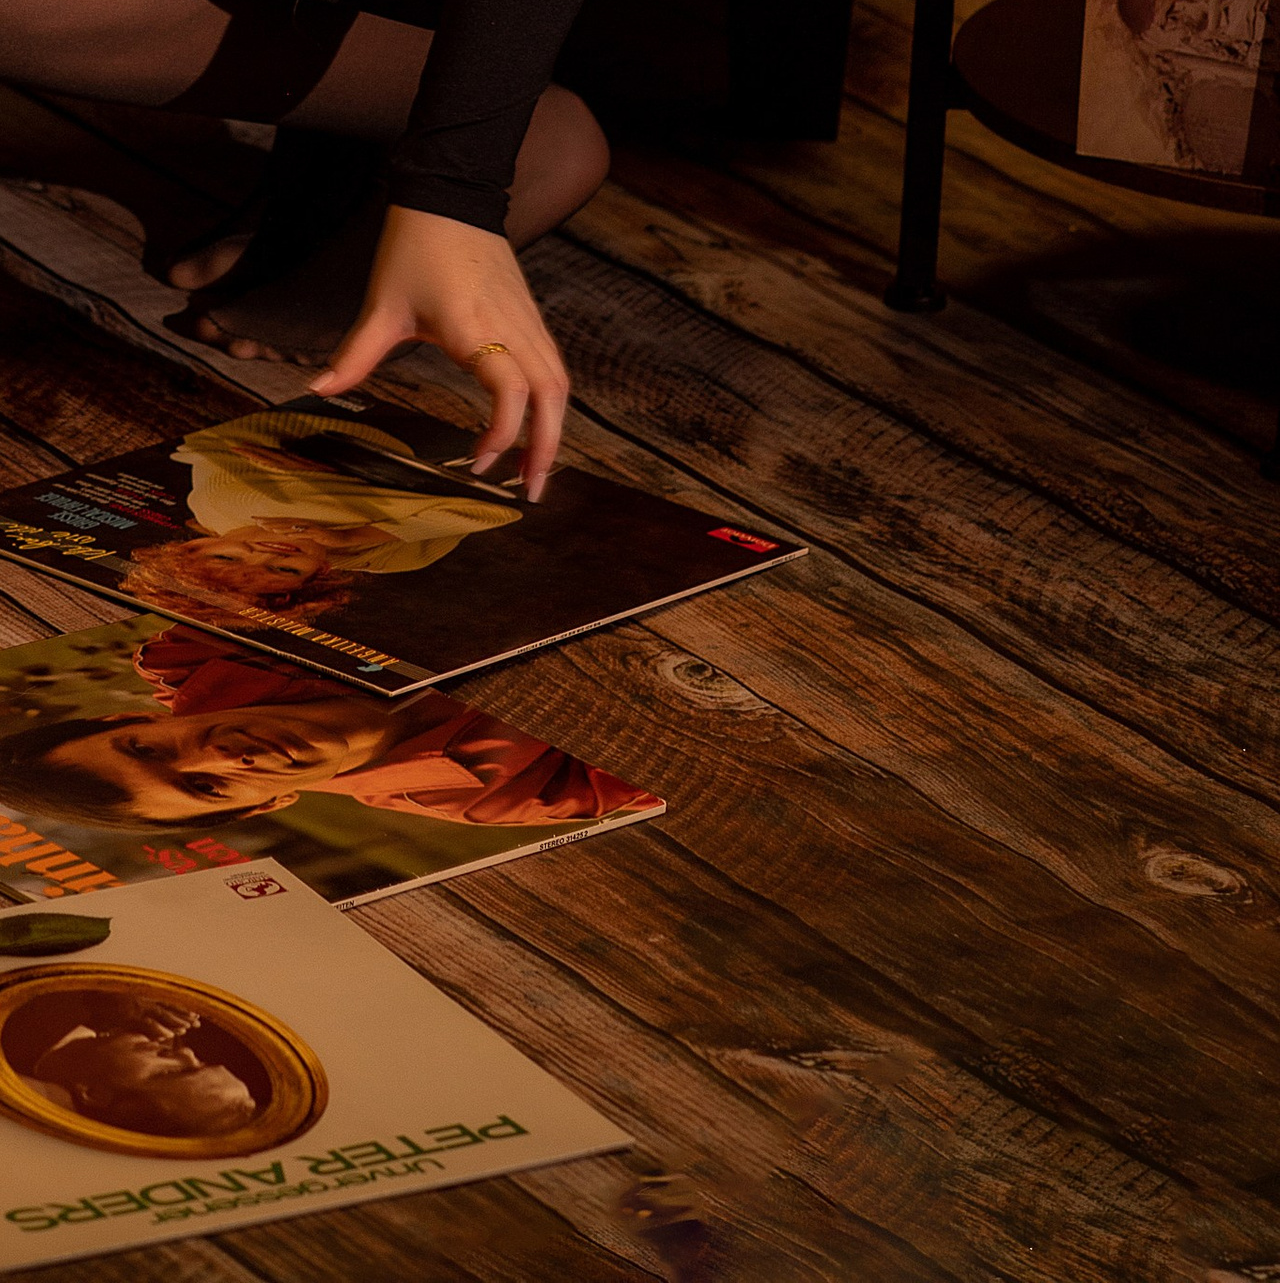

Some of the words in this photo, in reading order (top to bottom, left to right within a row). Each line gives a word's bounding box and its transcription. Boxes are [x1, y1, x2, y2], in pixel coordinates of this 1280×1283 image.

[47, 510, 100, 530] GROSSE
[238, 606, 315, 636] MILSTER
[312, 632, 400, 667] ANGELIKA
[540, 838, 565, 851] STEREO
[297, 1114, 531, 1175] PETER
[4, 1160, 287, 1232] ANDERS
[152, 1158, 446, 1225] Unvergessener
